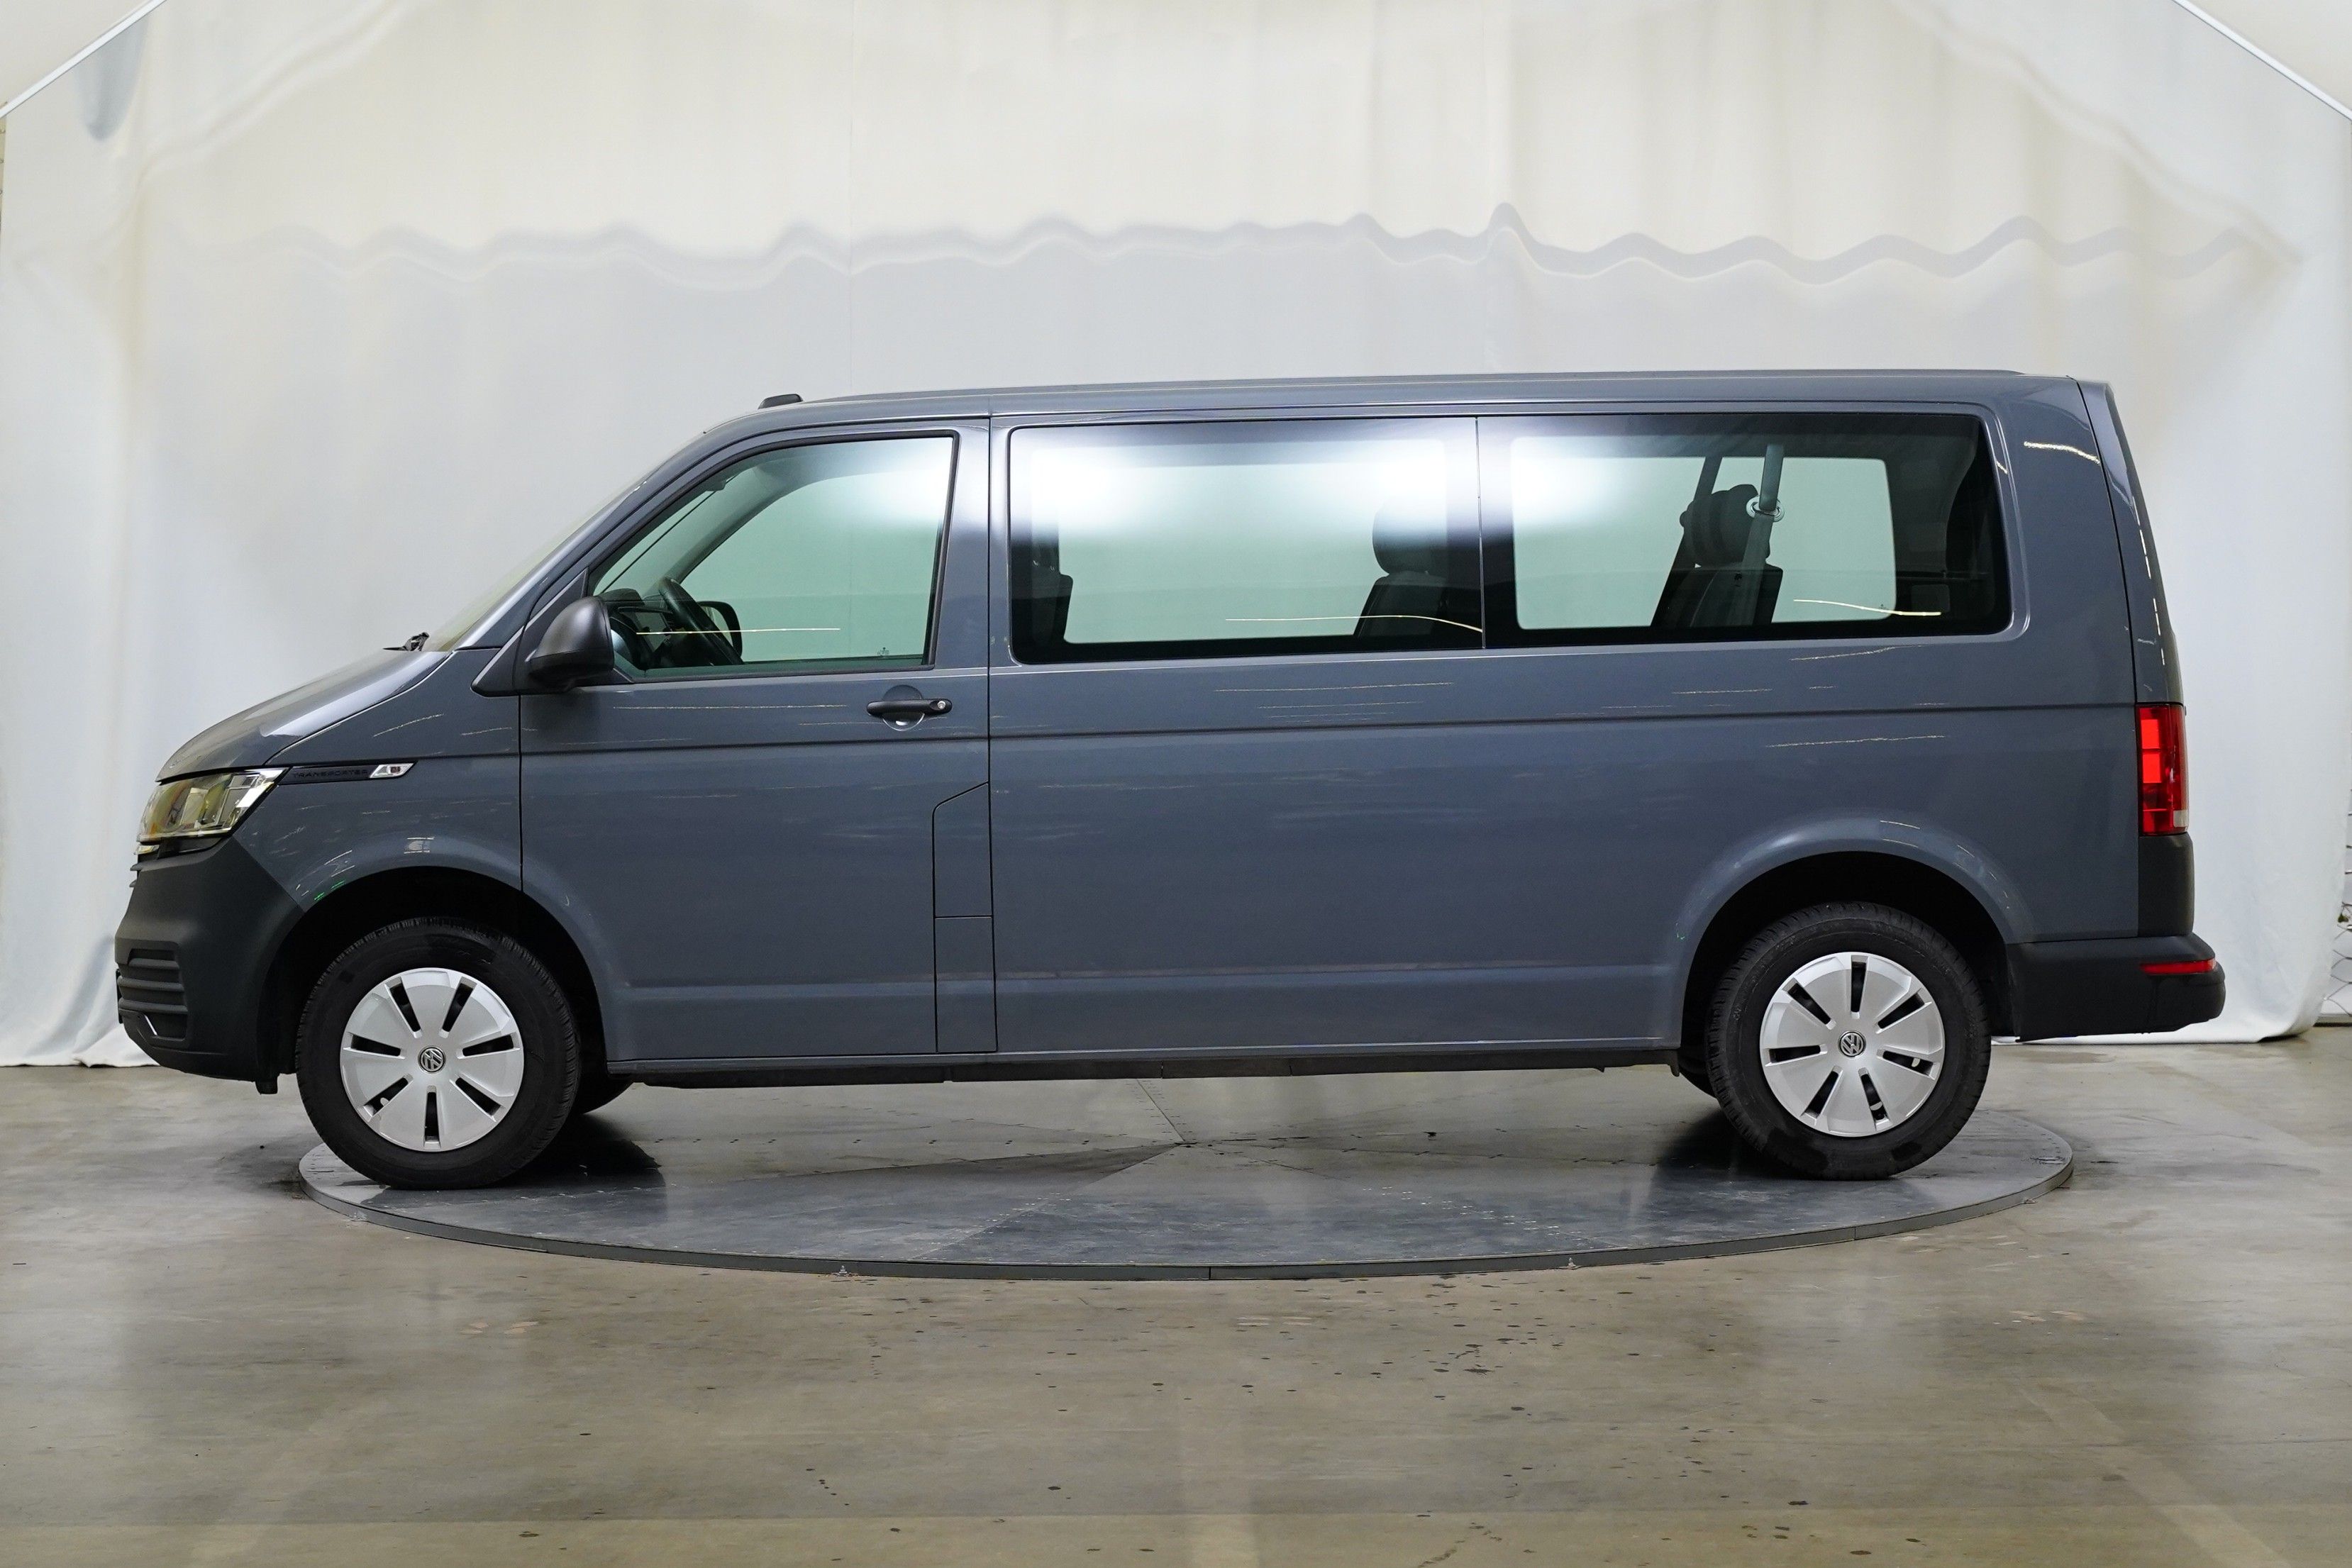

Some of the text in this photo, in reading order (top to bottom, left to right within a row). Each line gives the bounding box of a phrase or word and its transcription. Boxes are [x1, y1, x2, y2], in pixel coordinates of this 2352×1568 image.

[293, 769, 368, 778] TRANSPORTER
[1841, 1033, 1863, 1056] VW
[421, 1048, 443, 1072] VW
